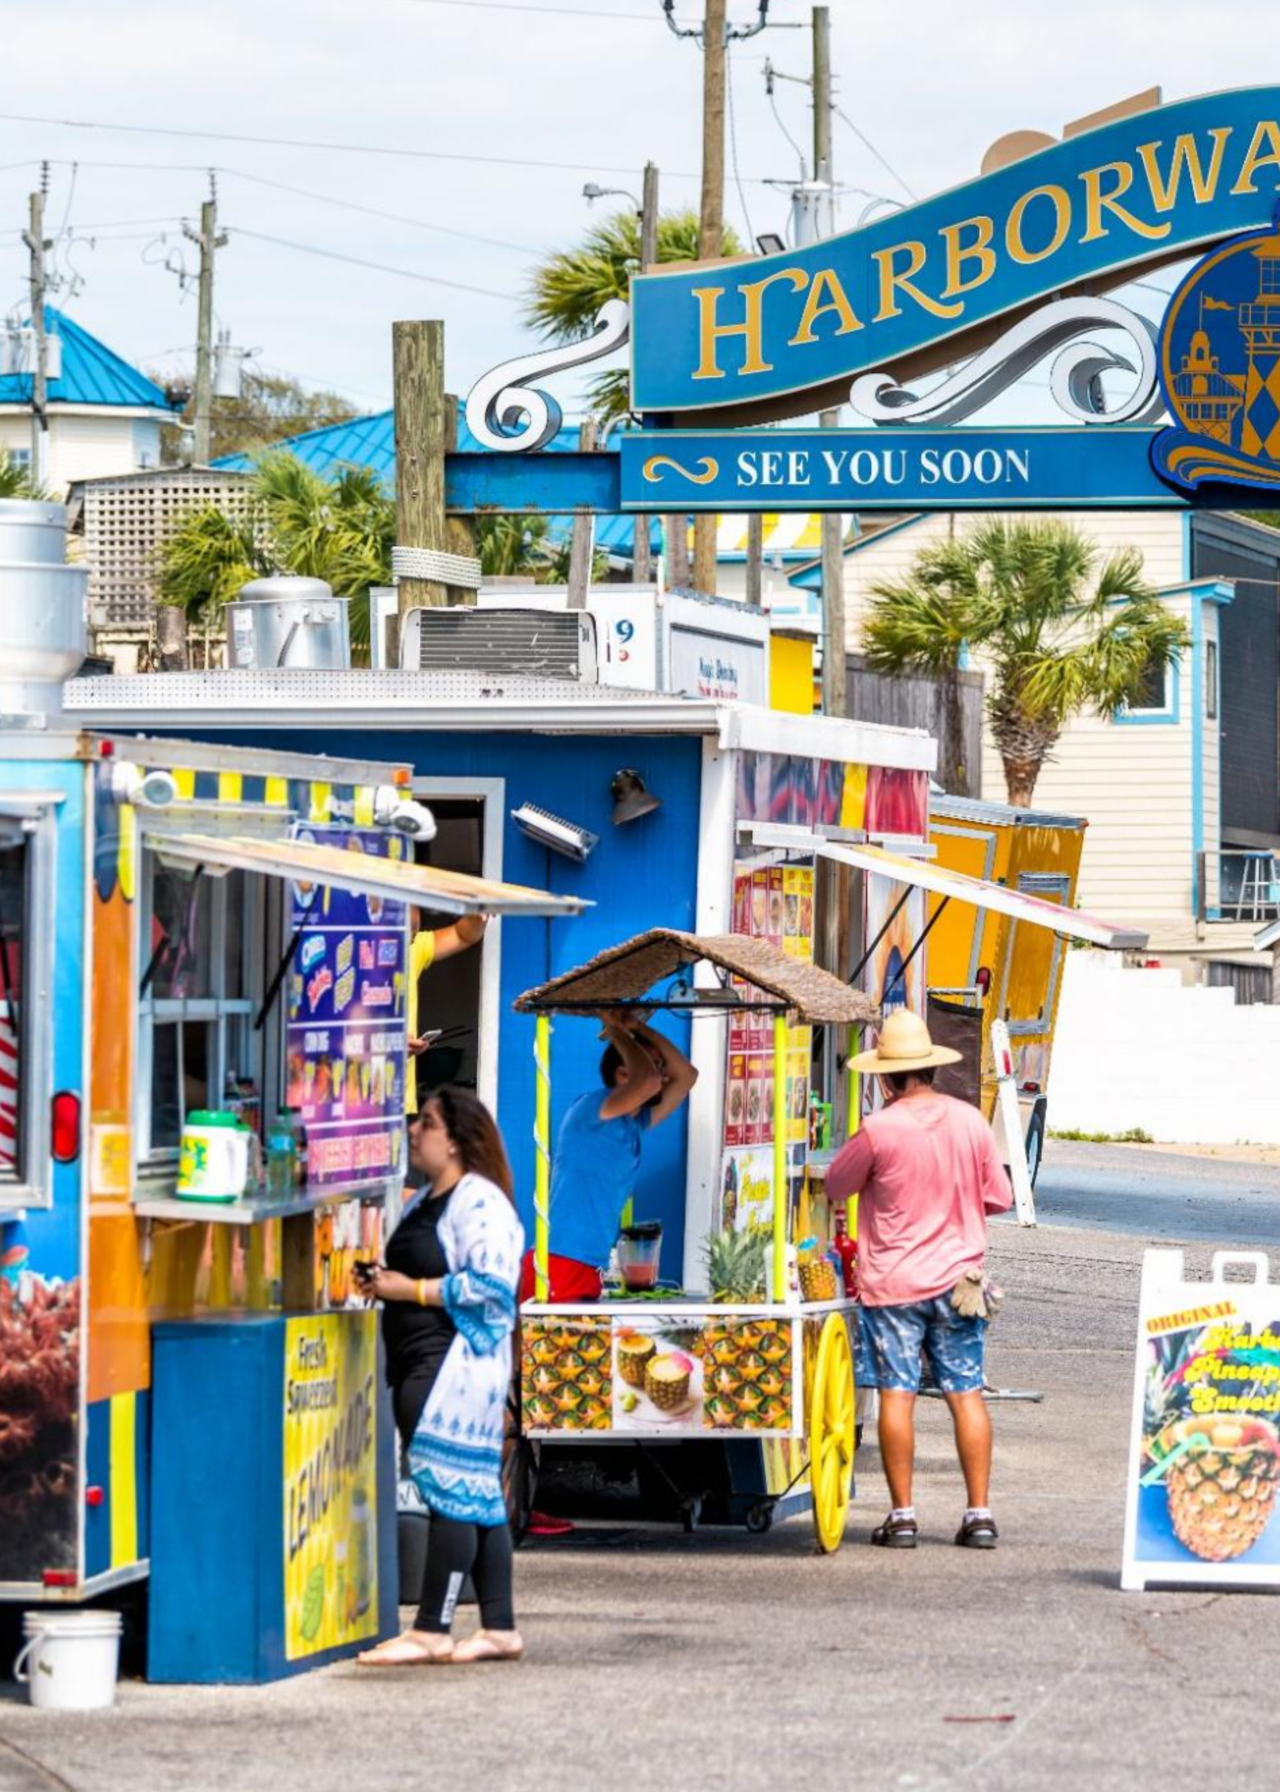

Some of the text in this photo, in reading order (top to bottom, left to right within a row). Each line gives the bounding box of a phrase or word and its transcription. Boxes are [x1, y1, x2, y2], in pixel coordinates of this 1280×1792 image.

[736, 448, 1031, 486] SEE YOU SOON
[1147, 1302, 1236, 1333] ORIGINAL
[298, 1326, 327, 1372] Fresh
[286, 1372, 338, 1427] Squeezed
[289, 1374, 372, 1561] LEMONADE
